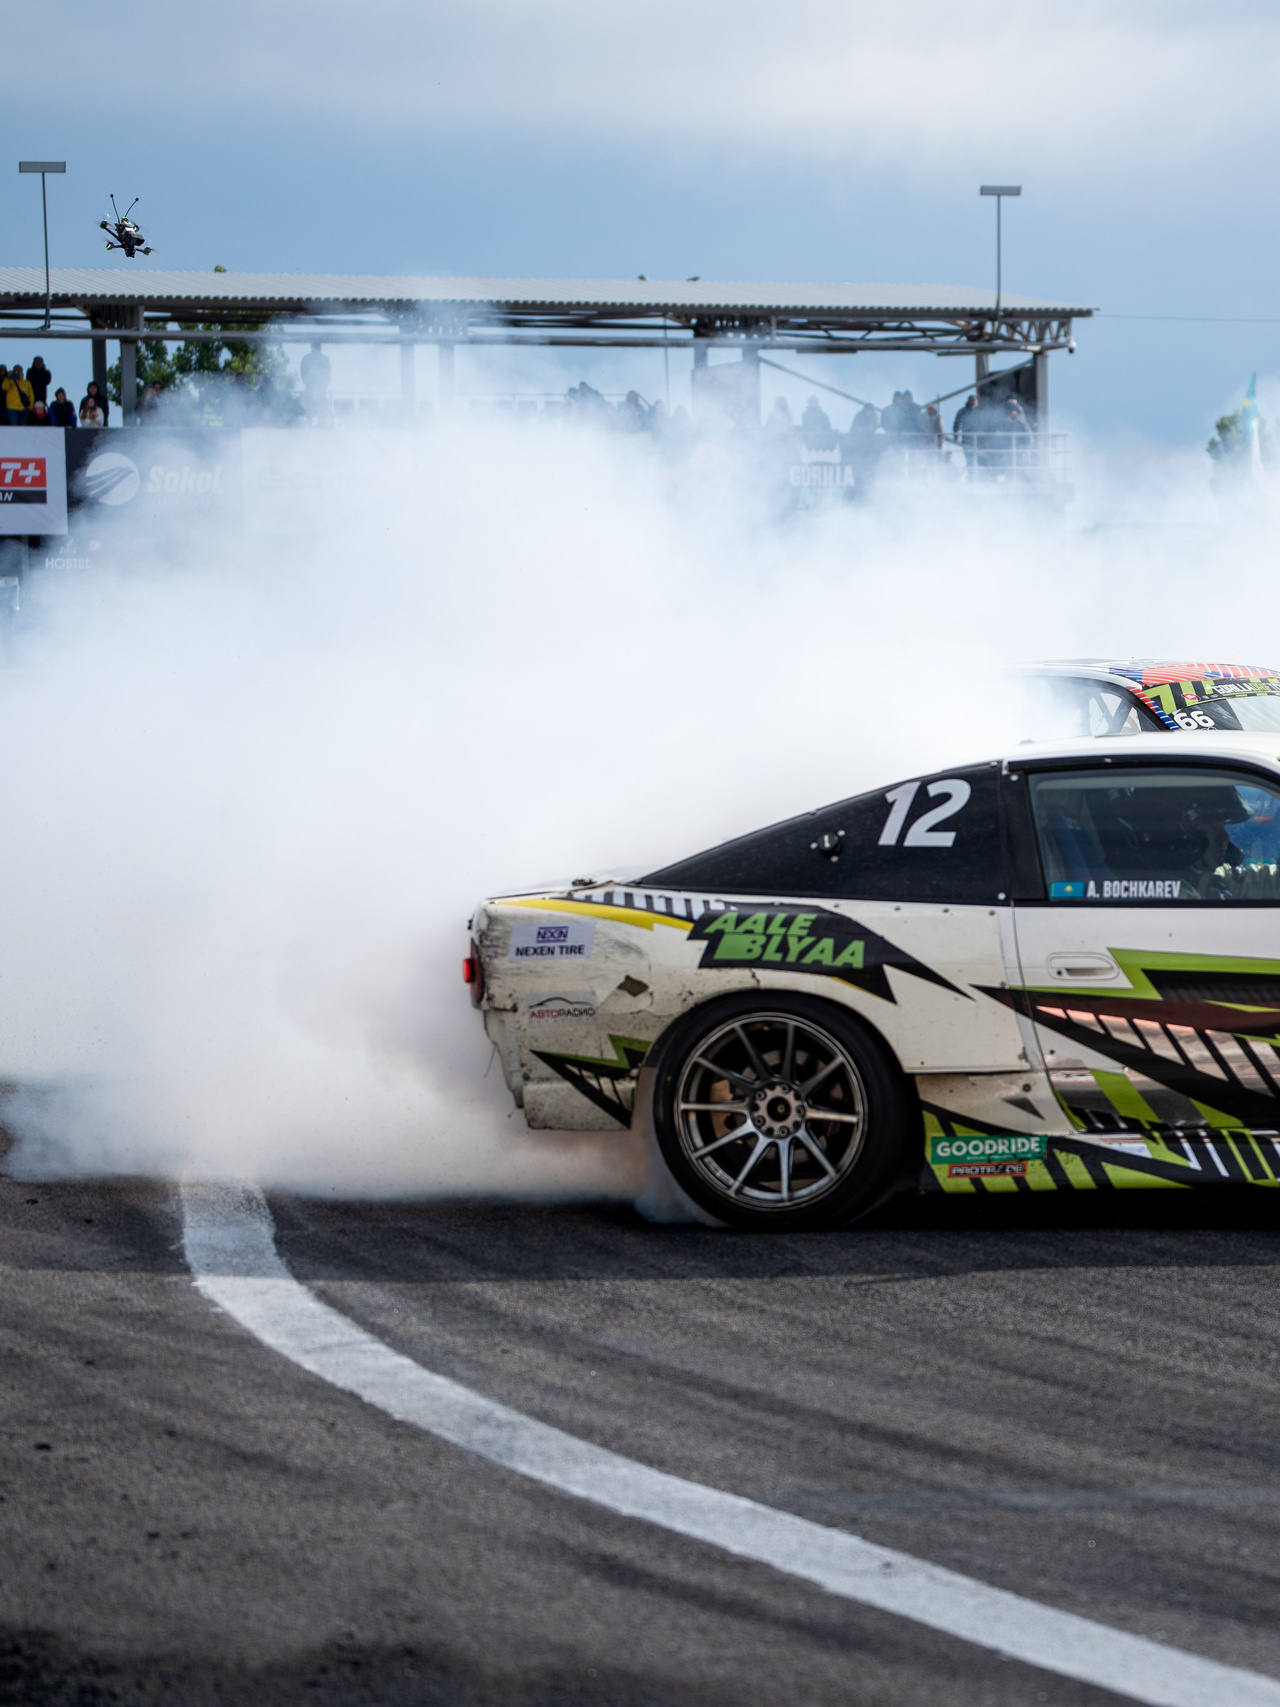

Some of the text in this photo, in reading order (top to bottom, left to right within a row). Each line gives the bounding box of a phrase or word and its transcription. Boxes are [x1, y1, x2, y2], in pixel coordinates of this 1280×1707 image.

[789, 465, 855, 487] GORILLA
[45, 557, 91, 569] HOSTEL
[1174, 710, 1215, 730] 66
[878, 779, 972, 847] 12
[1087, 880, 1181, 898] A. BOCHKAREV
[703, 912, 818, 936] AALE
[515, 944, 585, 956] NEXEN TIRE
[713, 934, 865, 968] BLYAA
[936, 1137, 1041, 1157] GOODRIDE
[952, 1164, 1024, 1176] PROTRDE
